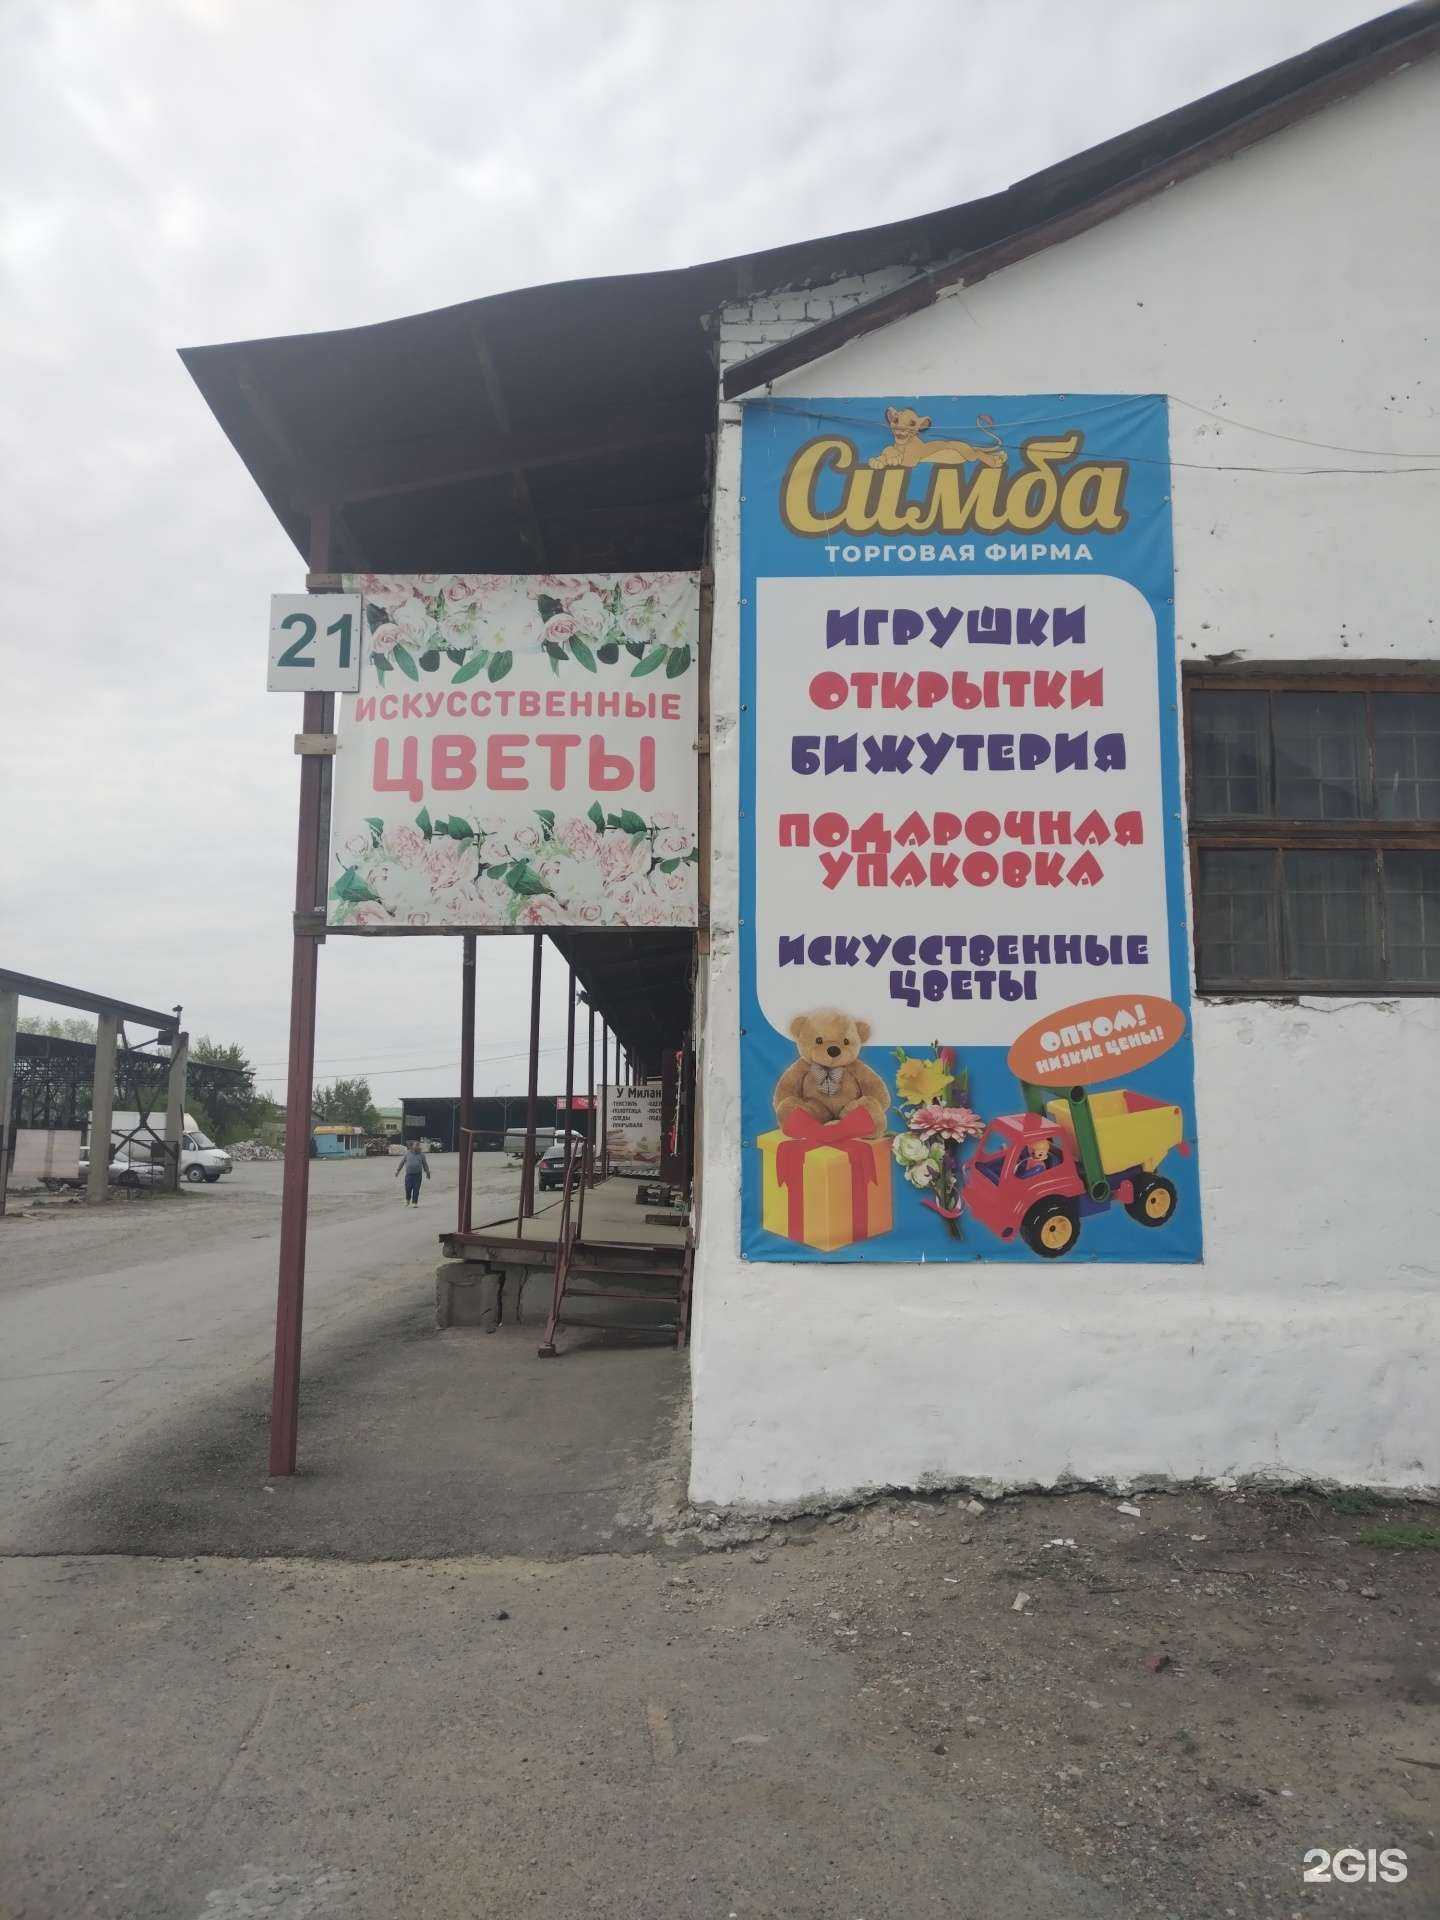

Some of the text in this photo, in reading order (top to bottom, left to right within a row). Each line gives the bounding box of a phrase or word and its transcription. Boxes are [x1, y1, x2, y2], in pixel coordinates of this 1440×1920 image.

[783, 433, 1126, 536] Симба
[825, 543, 1093, 562] ТОРГОВАЯ ФИРМА
[277, 612, 354, 669] 21
[826, 605, 1086, 649] ИГРУШКИ
[355, 689, 682, 722] ИСКУССТВЕННЫЕ
[809, 668, 1104, 711] ОТКРЫТКИ
[372, 733, 657, 803] ЦВЕТЫ
[791, 731, 1126, 775] БИЖУТЕРИЯ
[778, 809, 1144, 853] ПОДАРОЧНАЯ
[818, 849, 1105, 890] УПАКОВКА
[778, 934, 1149, 967] ИСКУССТВЕННЫЕ
[889, 969, 1037, 1008] ЦВЕТЫ
[1035, 1025, 1165, 1075] НИЗКИЕ ЦЕНЫ!
[1039, 1003, 1148, 1053] ОПТОМ!
[616, 1088, 624, 1099] У
